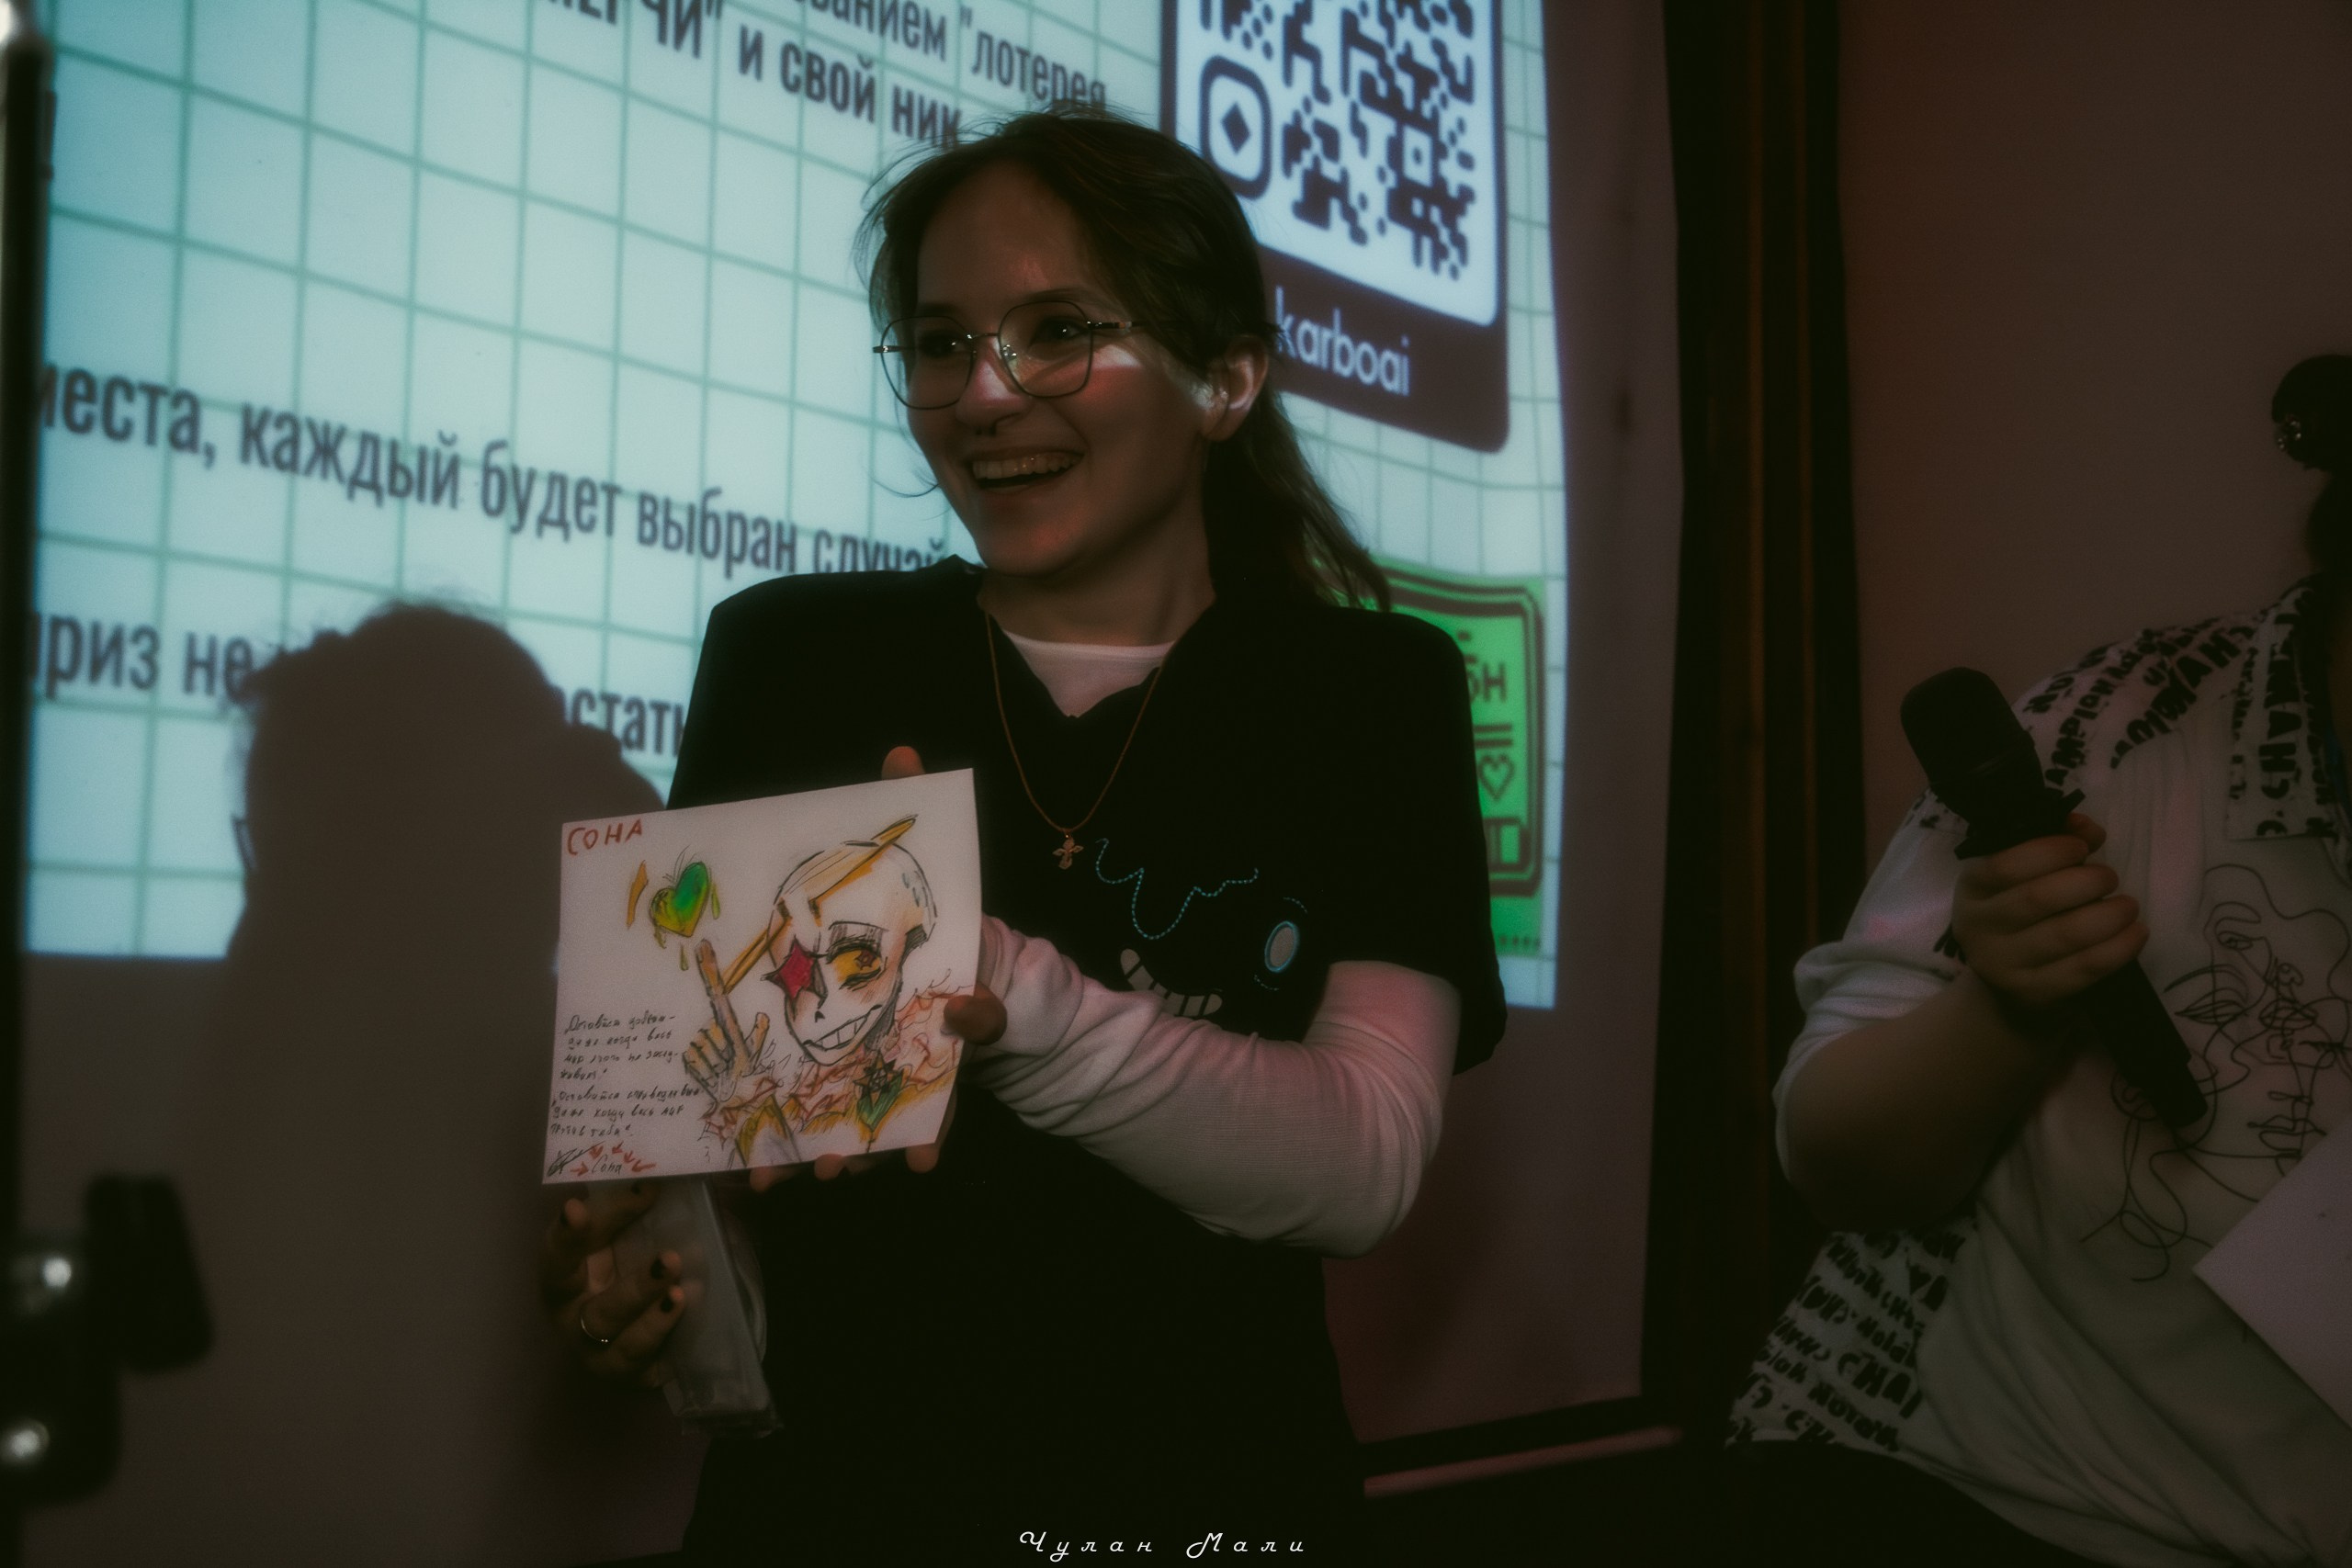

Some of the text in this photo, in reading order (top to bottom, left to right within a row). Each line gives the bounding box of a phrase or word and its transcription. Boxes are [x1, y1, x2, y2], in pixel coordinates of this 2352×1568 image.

[781, 41, 876, 125] свой
[1275, 285, 1411, 398] karboai
[237, 399, 462, 509] каждый
[479, 439, 622, 542] будет
[638, 486, 798, 579] выбран
[812, 528, 946, 573] случа
[35, 612, 161, 702] риз
[567, 818, 643, 856] СОНА
